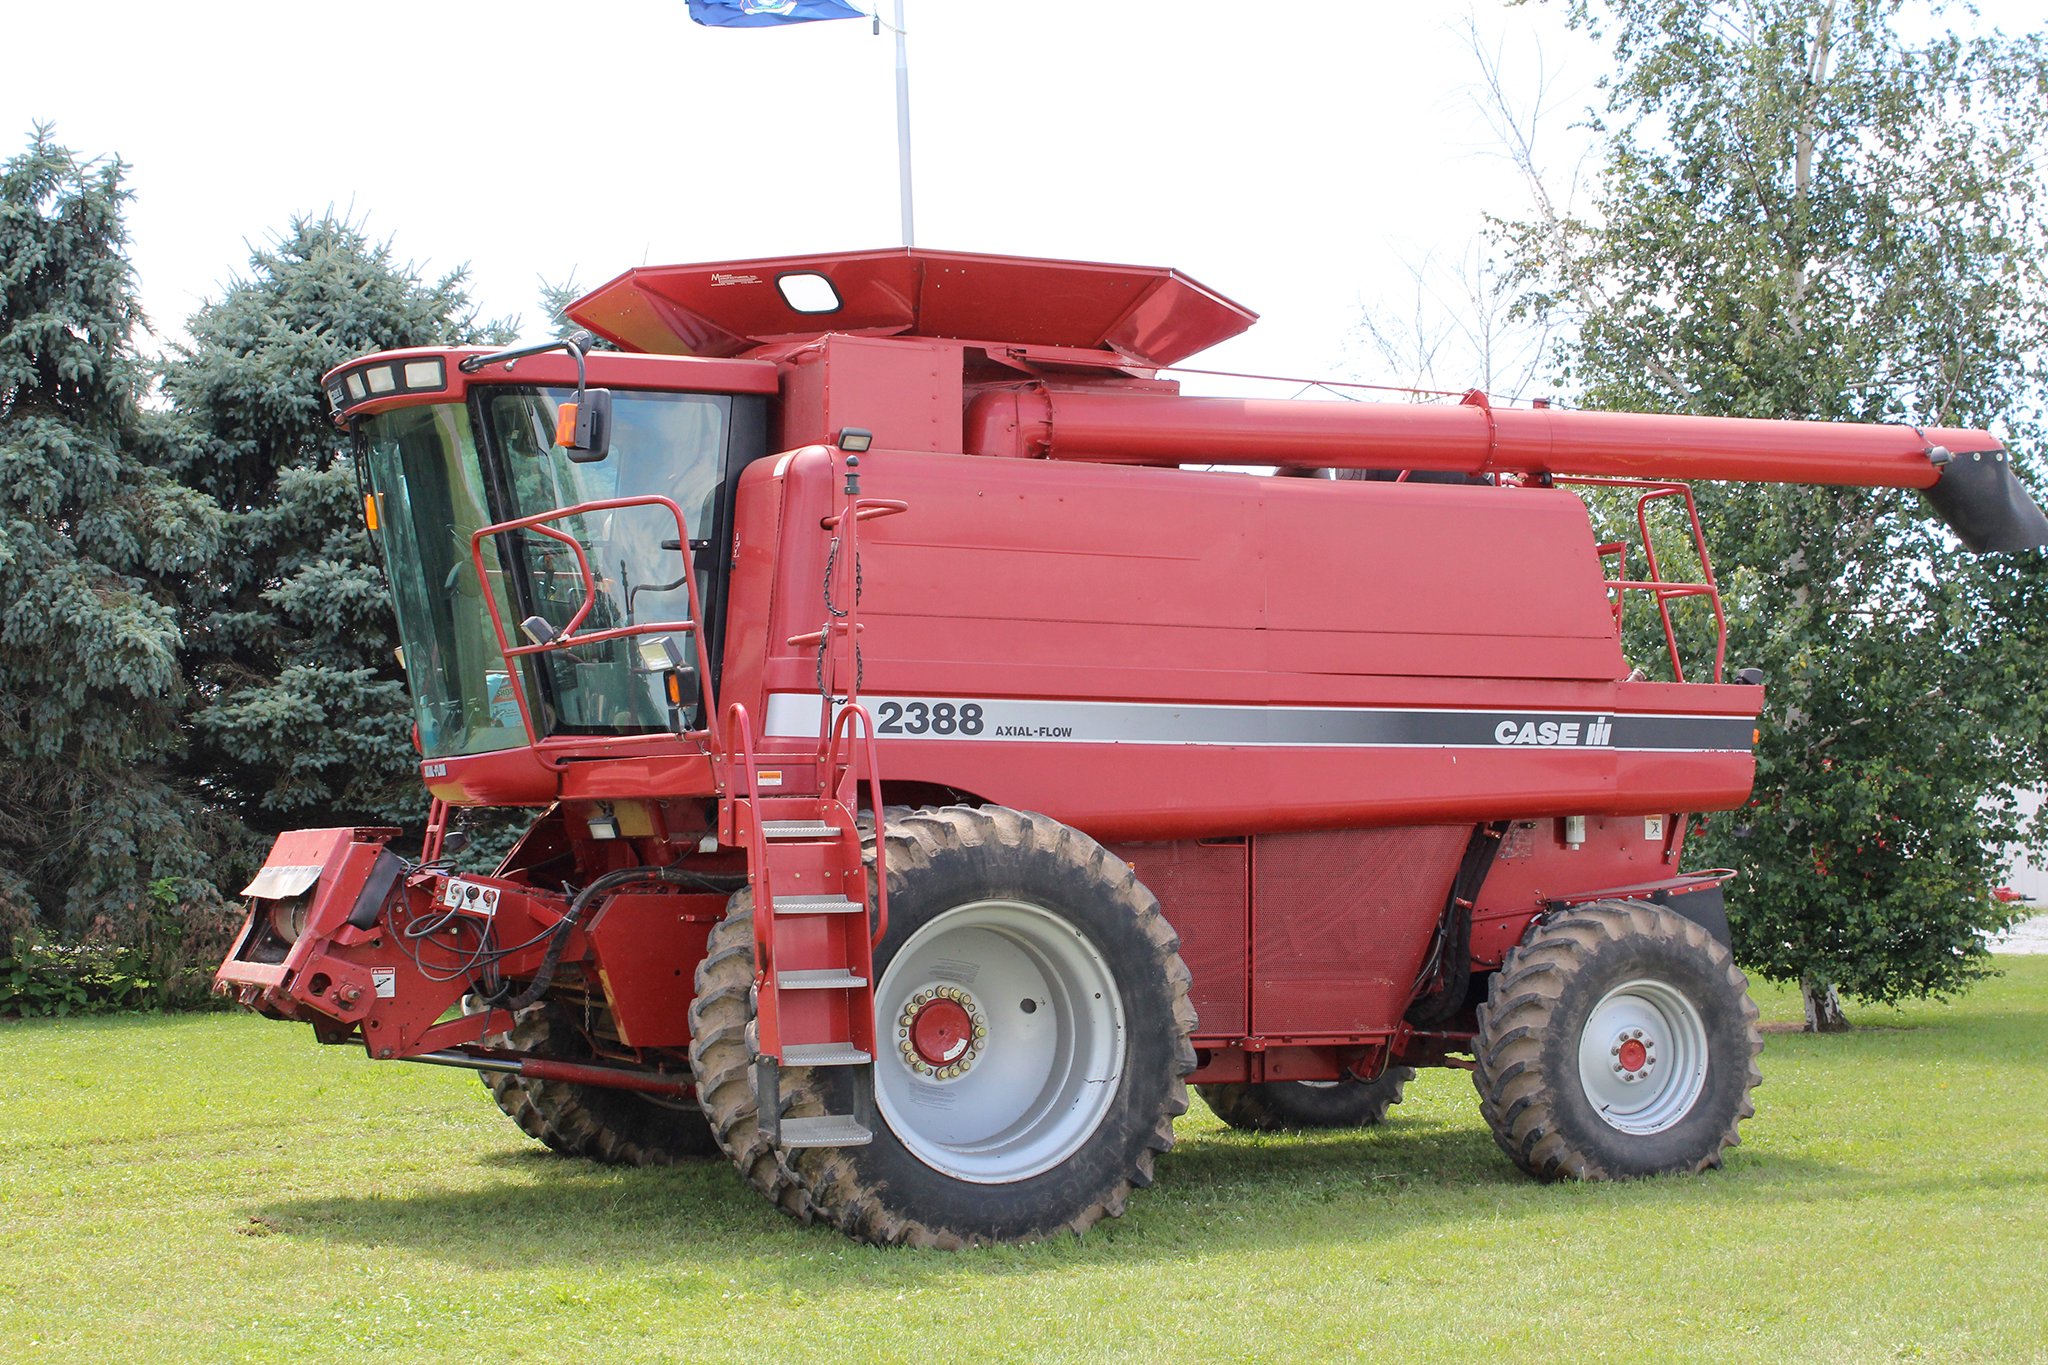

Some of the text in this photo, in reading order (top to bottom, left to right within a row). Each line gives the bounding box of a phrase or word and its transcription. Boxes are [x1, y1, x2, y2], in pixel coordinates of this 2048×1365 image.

[877, 702, 1072, 737] 2388 AXIAL-FLOW
[1494, 720, 1580, 745] CASE
